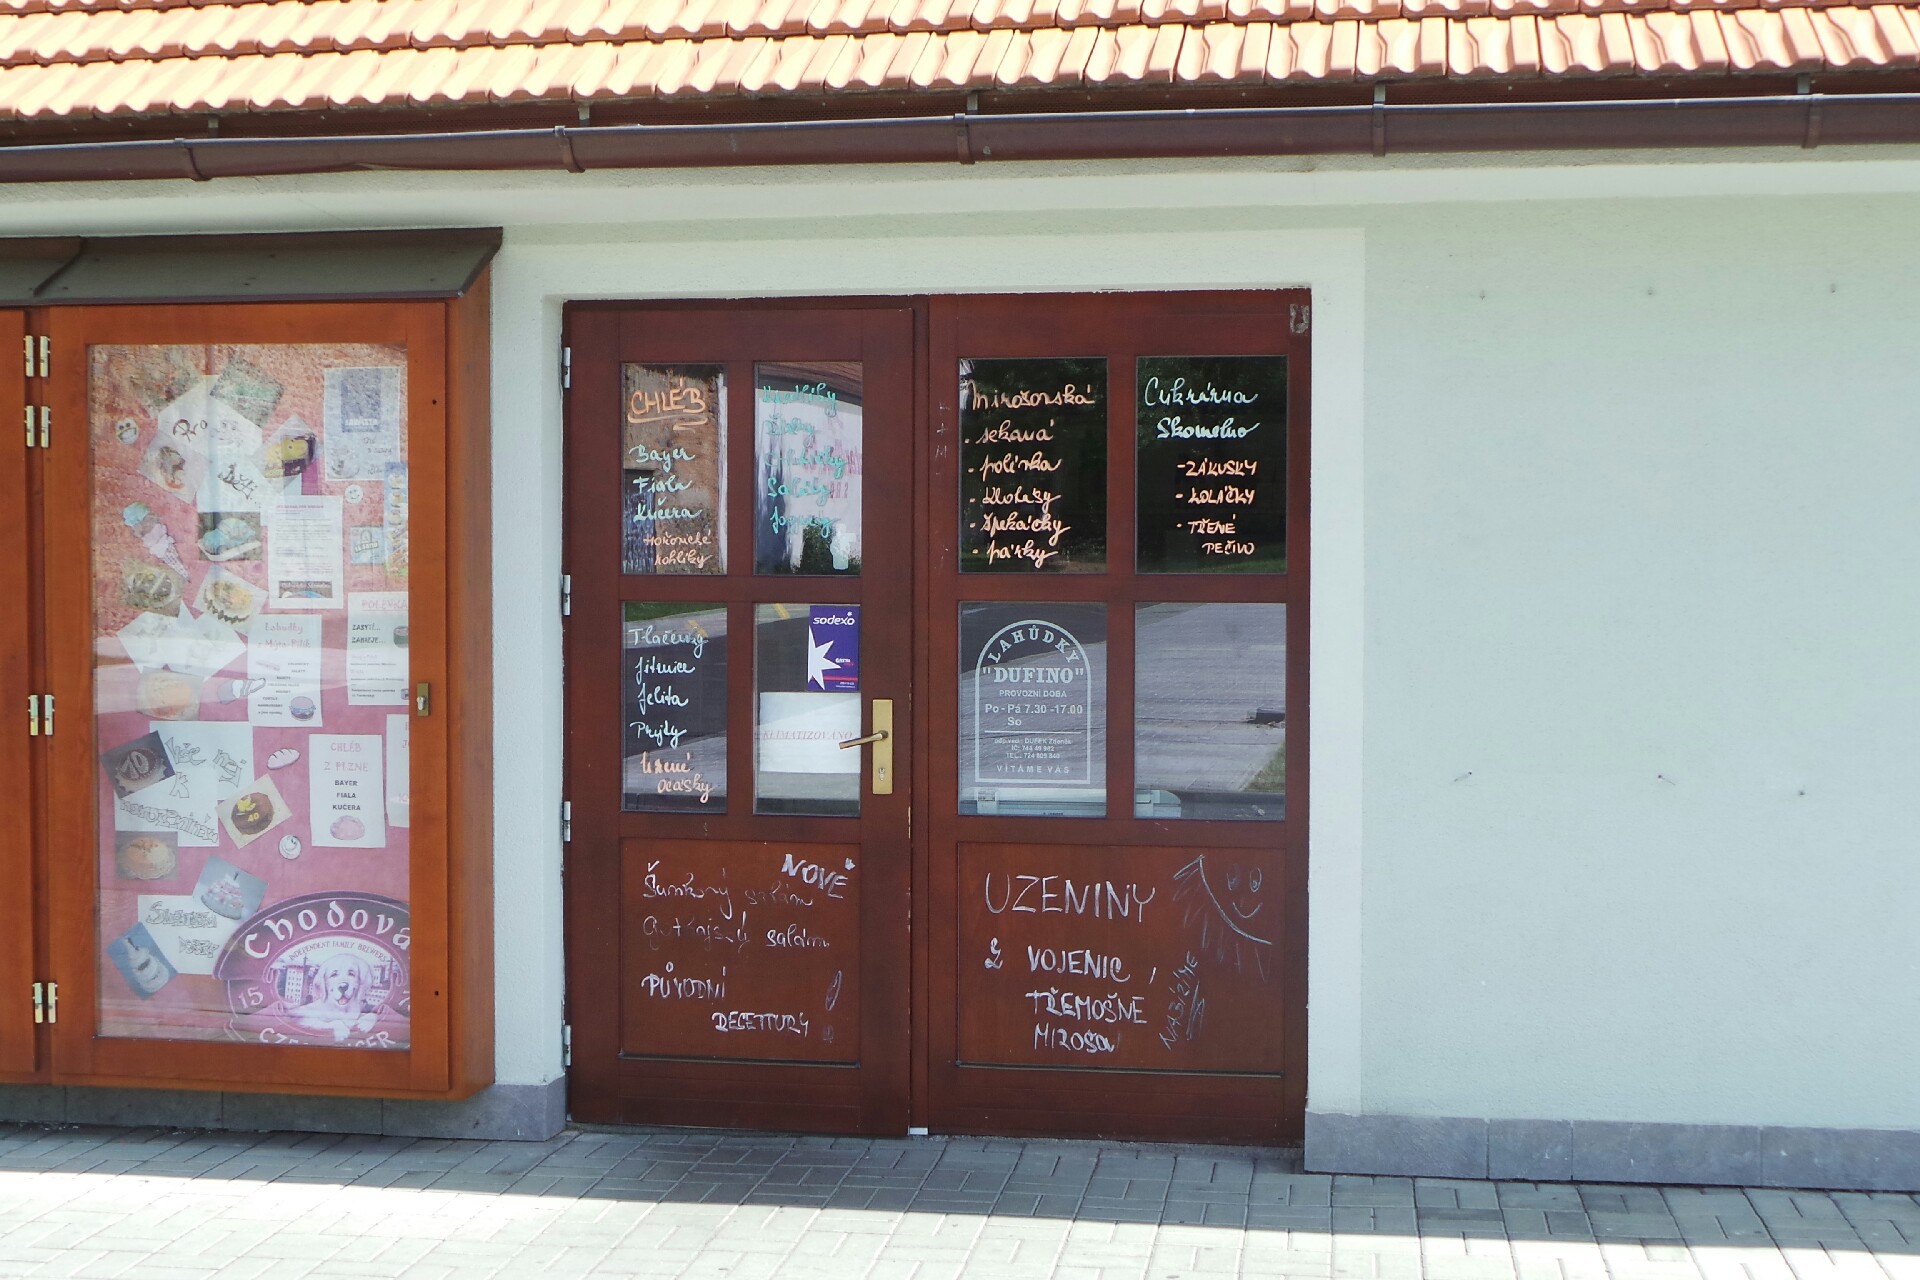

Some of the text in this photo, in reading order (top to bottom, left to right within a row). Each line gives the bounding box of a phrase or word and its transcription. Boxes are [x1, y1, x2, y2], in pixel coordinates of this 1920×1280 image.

[631, 379, 706, 414] CHLÉB
[1145, 377, 1259, 406] Cukrárna
[975, 419, 1055, 444] sekaná
[1157, 416, 1260, 439] Skomelno
[629, 444, 695, 473] Bayer
[633, 475, 692, 494] Fiala
[633, 496, 703, 522] Kučera
[1188, 514, 1236, 534] TŘENÉ
[987, 540, 1059, 569] párky
[1201, 540, 1255, 555] PEČIVO
[813, 615, 855, 626] sodexo
[988, 625, 1079, 663] LAHŮDKY
[635, 656, 695, 685] Jitrnice
[983, 667, 1083, 683] "DUFINO"
[638, 683, 689, 715] Jelita
[1000, 689, 1067, 698] PROVOZNÍ DOBA
[985, 703, 999, 713] Po
[1007, 703, 1021, 714] Pá
[1024, 704, 1047, 714] 7.30
[1007, 717, 1022, 726] So
[763, 730, 853, 741] KLIMATIZOVÁNO
[997, 764, 1070, 774] VÍTÁME VÁS
[985, 873, 1155, 922] UZENINY
[289, 940, 388, 963] INDEPENDENT FAMILY BREWERS
[641, 961, 726, 999] PŮVODNÍ
[238, 987, 263, 1009] 15
